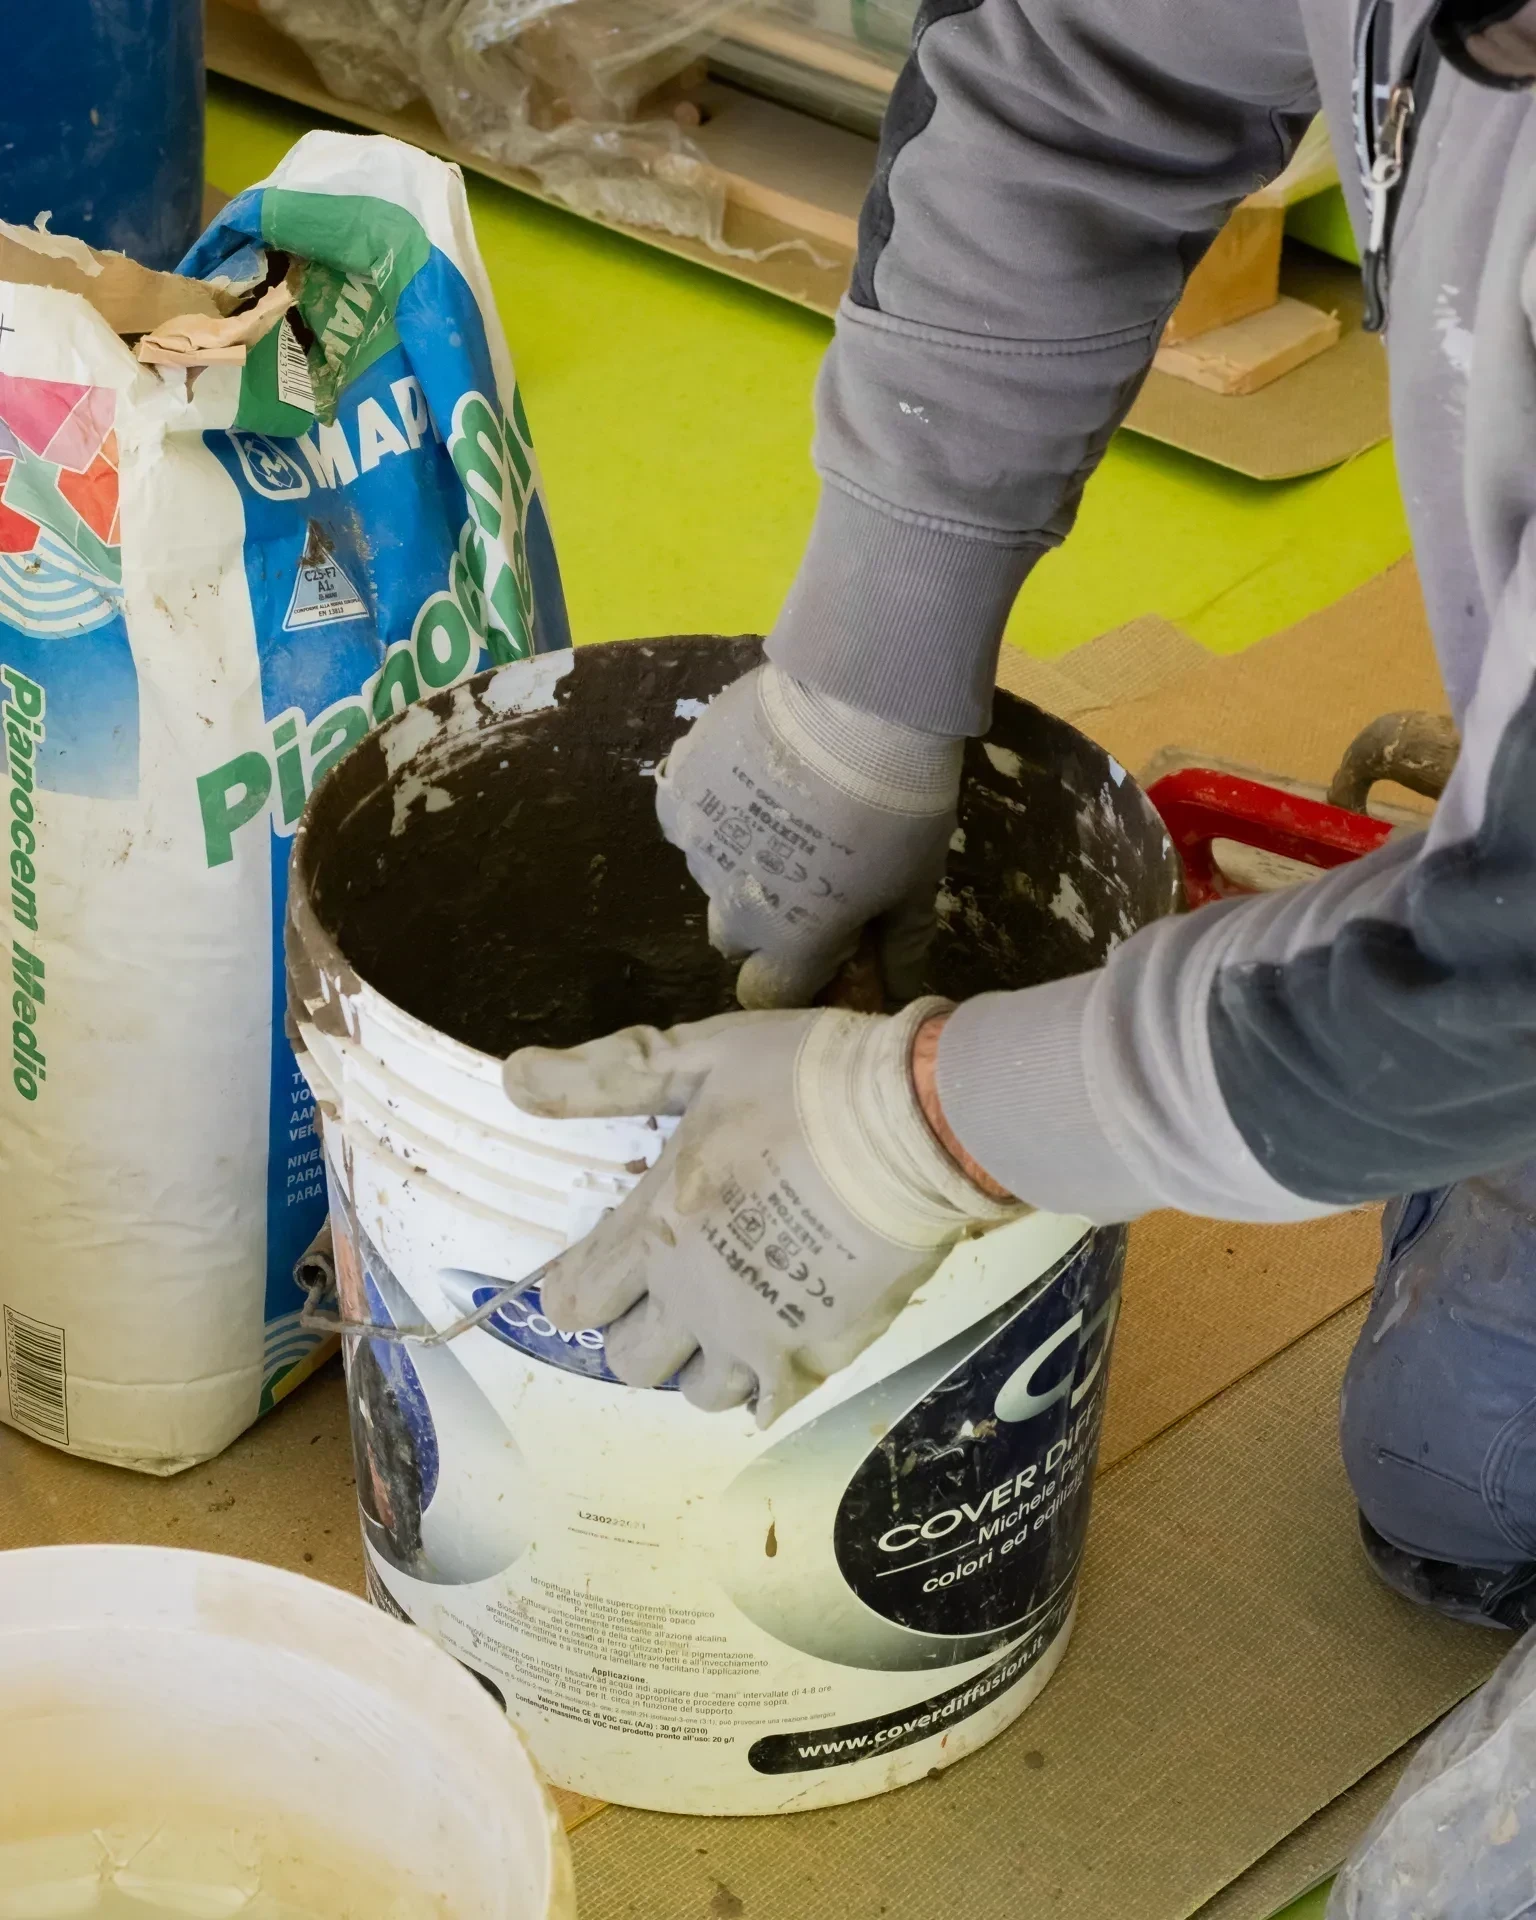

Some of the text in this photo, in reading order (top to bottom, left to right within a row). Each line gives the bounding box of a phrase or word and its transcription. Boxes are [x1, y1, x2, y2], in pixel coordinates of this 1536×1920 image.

[294, 606, 318, 614] CONFORME
[329, 607, 344, 615] 13813
[3, 666, 46, 1102] Pianocem Medio
[286, 1165, 323, 1188] PARA
[287, 1183, 323, 1207] PARA
[497, 1299, 604, 1350] Cove
[878, 1464, 1038, 1552] COVER
[978, 1480, 1056, 1545] Michele
[922, 1464, 1085, 1592] colori ed edilizia
[530, 1576, 715, 1618] Idropittura lavabile supercoprente tixotropico
[545, 1590, 696, 1626] ad effetto vellutato per interno opaco
[574, 1606, 588, 1616] Per
[590, 1612, 604, 1620] uso
[486, 1604, 530, 1630] garantiscono
[532, 1625, 557, 1639] ottima
[559, 1634, 598, 1650] resistenza
[600, 1644, 608, 1652] ai
[610, 1646, 632, 1658] raggi
[633, 1652, 680, 1664] ultravioletti
[538, 1618, 562, 1633] titanio
[598, 1636, 605, 1644] di
[607, 1638, 627, 1648] ferro
[629, 1643, 663, 1654] utilizzati
[666, 1648, 679, 1657] per
[548, 1606, 610, 1629] particolarmente
[654, 1631, 692, 1642] all'azione
[695, 1634, 727, 1643] alcalina
[551, 1616, 563, 1625] del
[565, 1620, 599, 1634] cemento
[608, 1632, 628, 1642] della
[630, 1636, 652, 1645] calce
[492, 1615, 519, 1634] Cariche
[521, 1628, 558, 1648] riempitive
[573, 1646, 607, 1662] struttura
[610, 1655, 646, 1669] lamellare
[649, 1662, 659, 1670] ne
[662, 1663, 700, 1674] facilitano
[487, 1636, 520, 1657] preparare
[521, 1652, 535, 1663] con
[541, 1660, 563, 1673] nostri
[565, 1666, 594, 1682] fissativi
[597, 1676, 607, 1684] ad
[609, 1680, 633, 1692] acqua
[636, 1682, 650, 1693] indi
[653, 1687, 690, 1698] applicare
[694, 1690, 709, 1699] due
[743, 1690, 789, 1700] intervallate
[792, 1688, 799, 1696] di
[592, 1666, 648, 1684] Applicazione.
[554, 1680, 566, 1690] 7/8
[585, 1690, 598, 1700] per
[611, 1696, 630, 1705] circa
[632, 1698, 640, 1706] in
[642, 1700, 678, 1712] funzione
[680, 1704, 693, 1713] del
[564, 1676, 598, 1691] stuccare
[600, 1684, 607, 1692] in
[609, 1686, 633, 1698] modo
[635, 1692, 684, 1704] appropriato
[694, 1698, 736, 1708] procedere
[738, 1700, 761, 1708] come
[798, 1634, 1044, 1758] www.coverdiffusion.it
[515, 1692, 549, 1712] Contenuto
[550, 1708, 582, 1722] massimo
[584, 1716, 591, 1724] di
[592, 1720, 608, 1728] VOC
[609, 1724, 620, 1732] nel
[622, 1726, 654, 1738] prodotto
[656, 1732, 680, 1741] pronto
[682, 1734, 711, 1743] all'uso:
[538, 1694, 559, 1708] Valore
[560, 1702, 580, 1714] limite
[582, 1709, 592, 1717] CE
[593, 1712, 601, 1720] di
[602, 1714, 617, 1723] VOC
[635, 1720, 654, 1730] (A/a)
[660, 1724, 670, 1732] 30
[684, 1726, 708, 1736] (2010)
[781, 1714, 808, 1724] reazione
